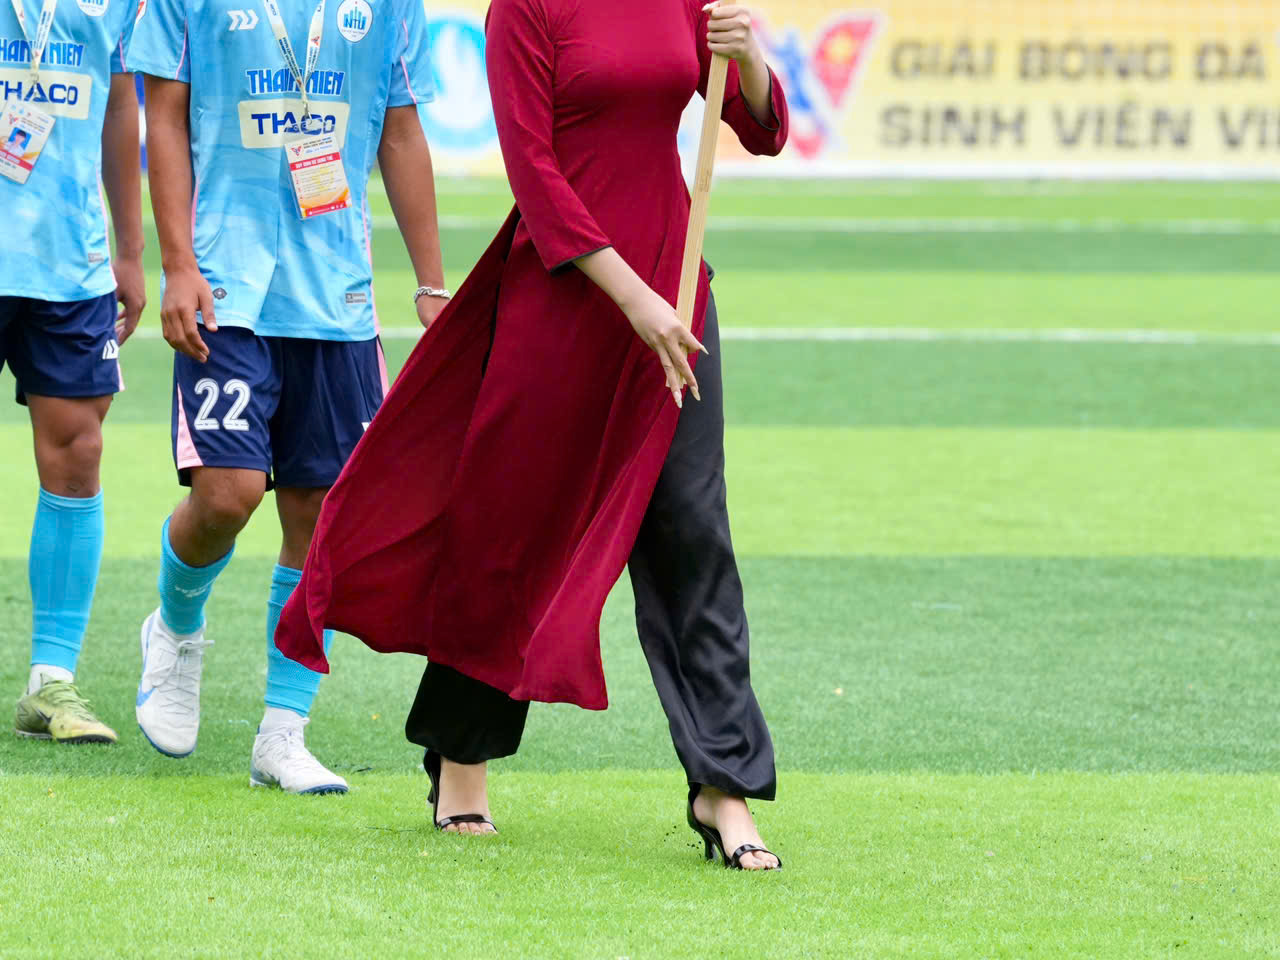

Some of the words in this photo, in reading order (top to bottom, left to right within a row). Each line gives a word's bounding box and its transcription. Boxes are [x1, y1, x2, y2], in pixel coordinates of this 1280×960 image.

[343, 16, 367, 31] NTU
[879, 102, 1028, 147] SINH
[193, 377, 251, 432] 22
